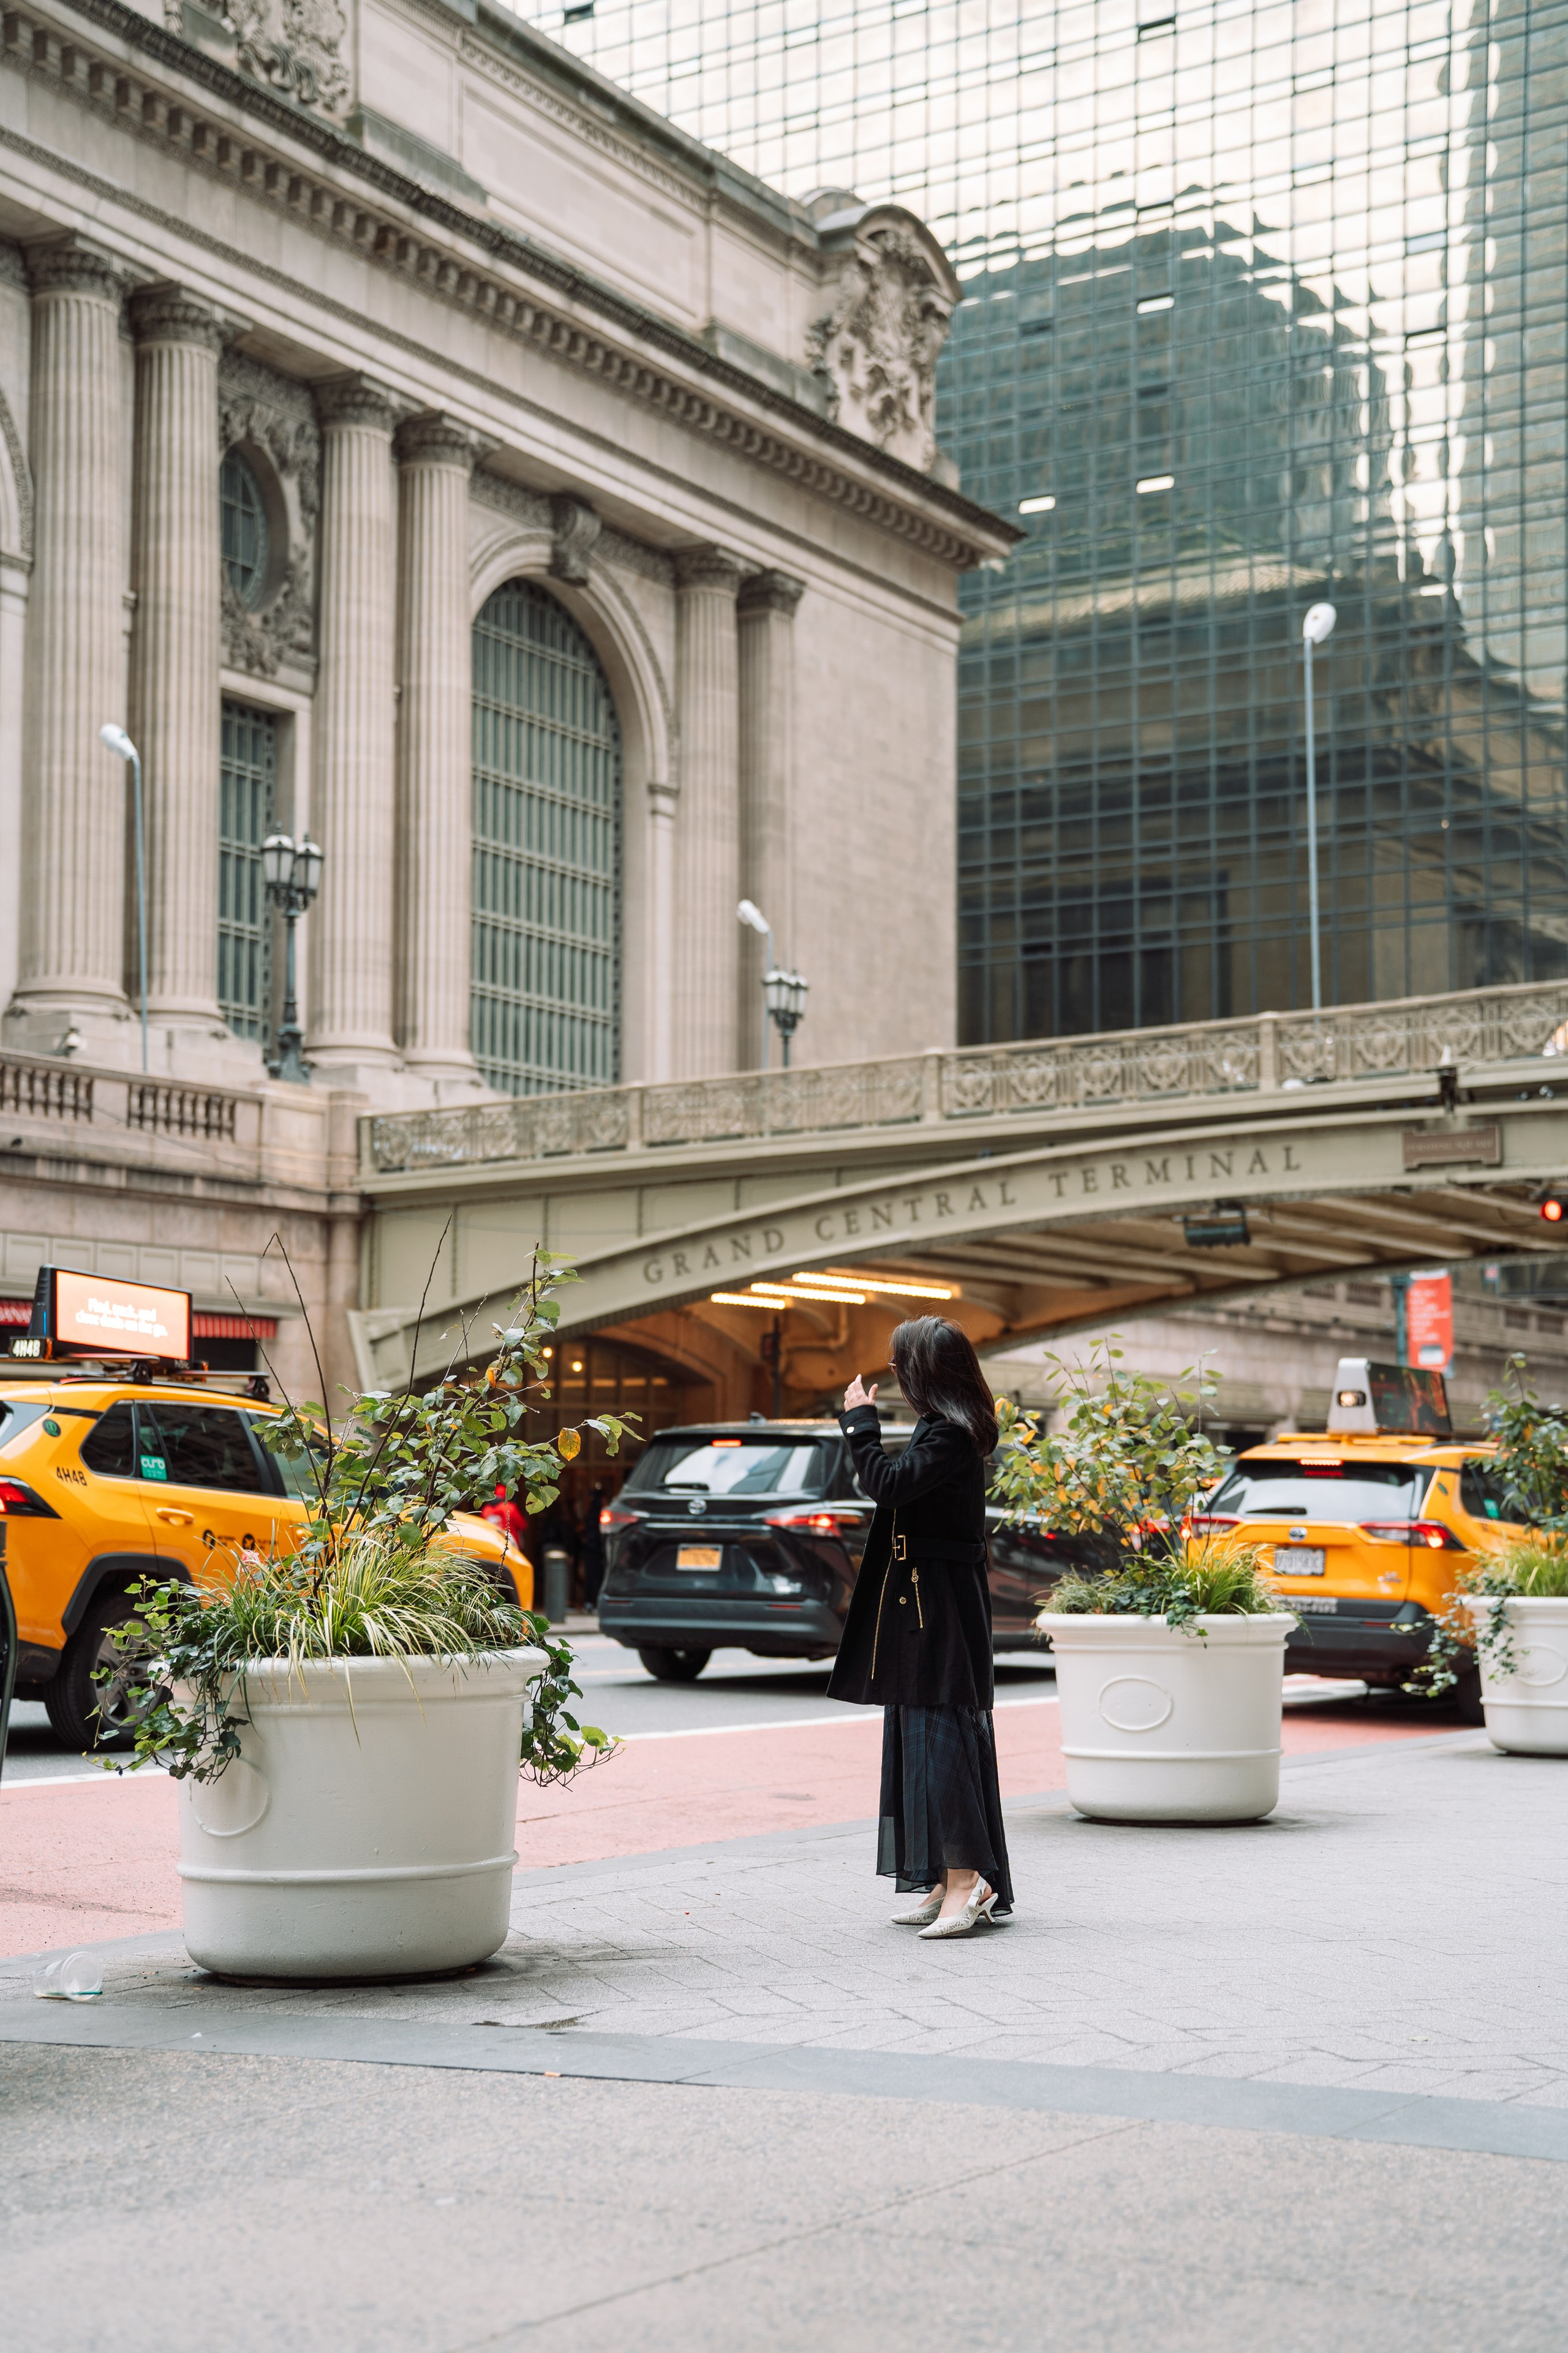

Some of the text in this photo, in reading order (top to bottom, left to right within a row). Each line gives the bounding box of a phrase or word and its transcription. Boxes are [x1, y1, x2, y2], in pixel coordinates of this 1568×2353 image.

[643, 1145, 1303, 1285] GRAND CENTRAL TERMINAL
[141, 1457, 165, 1470] curb
